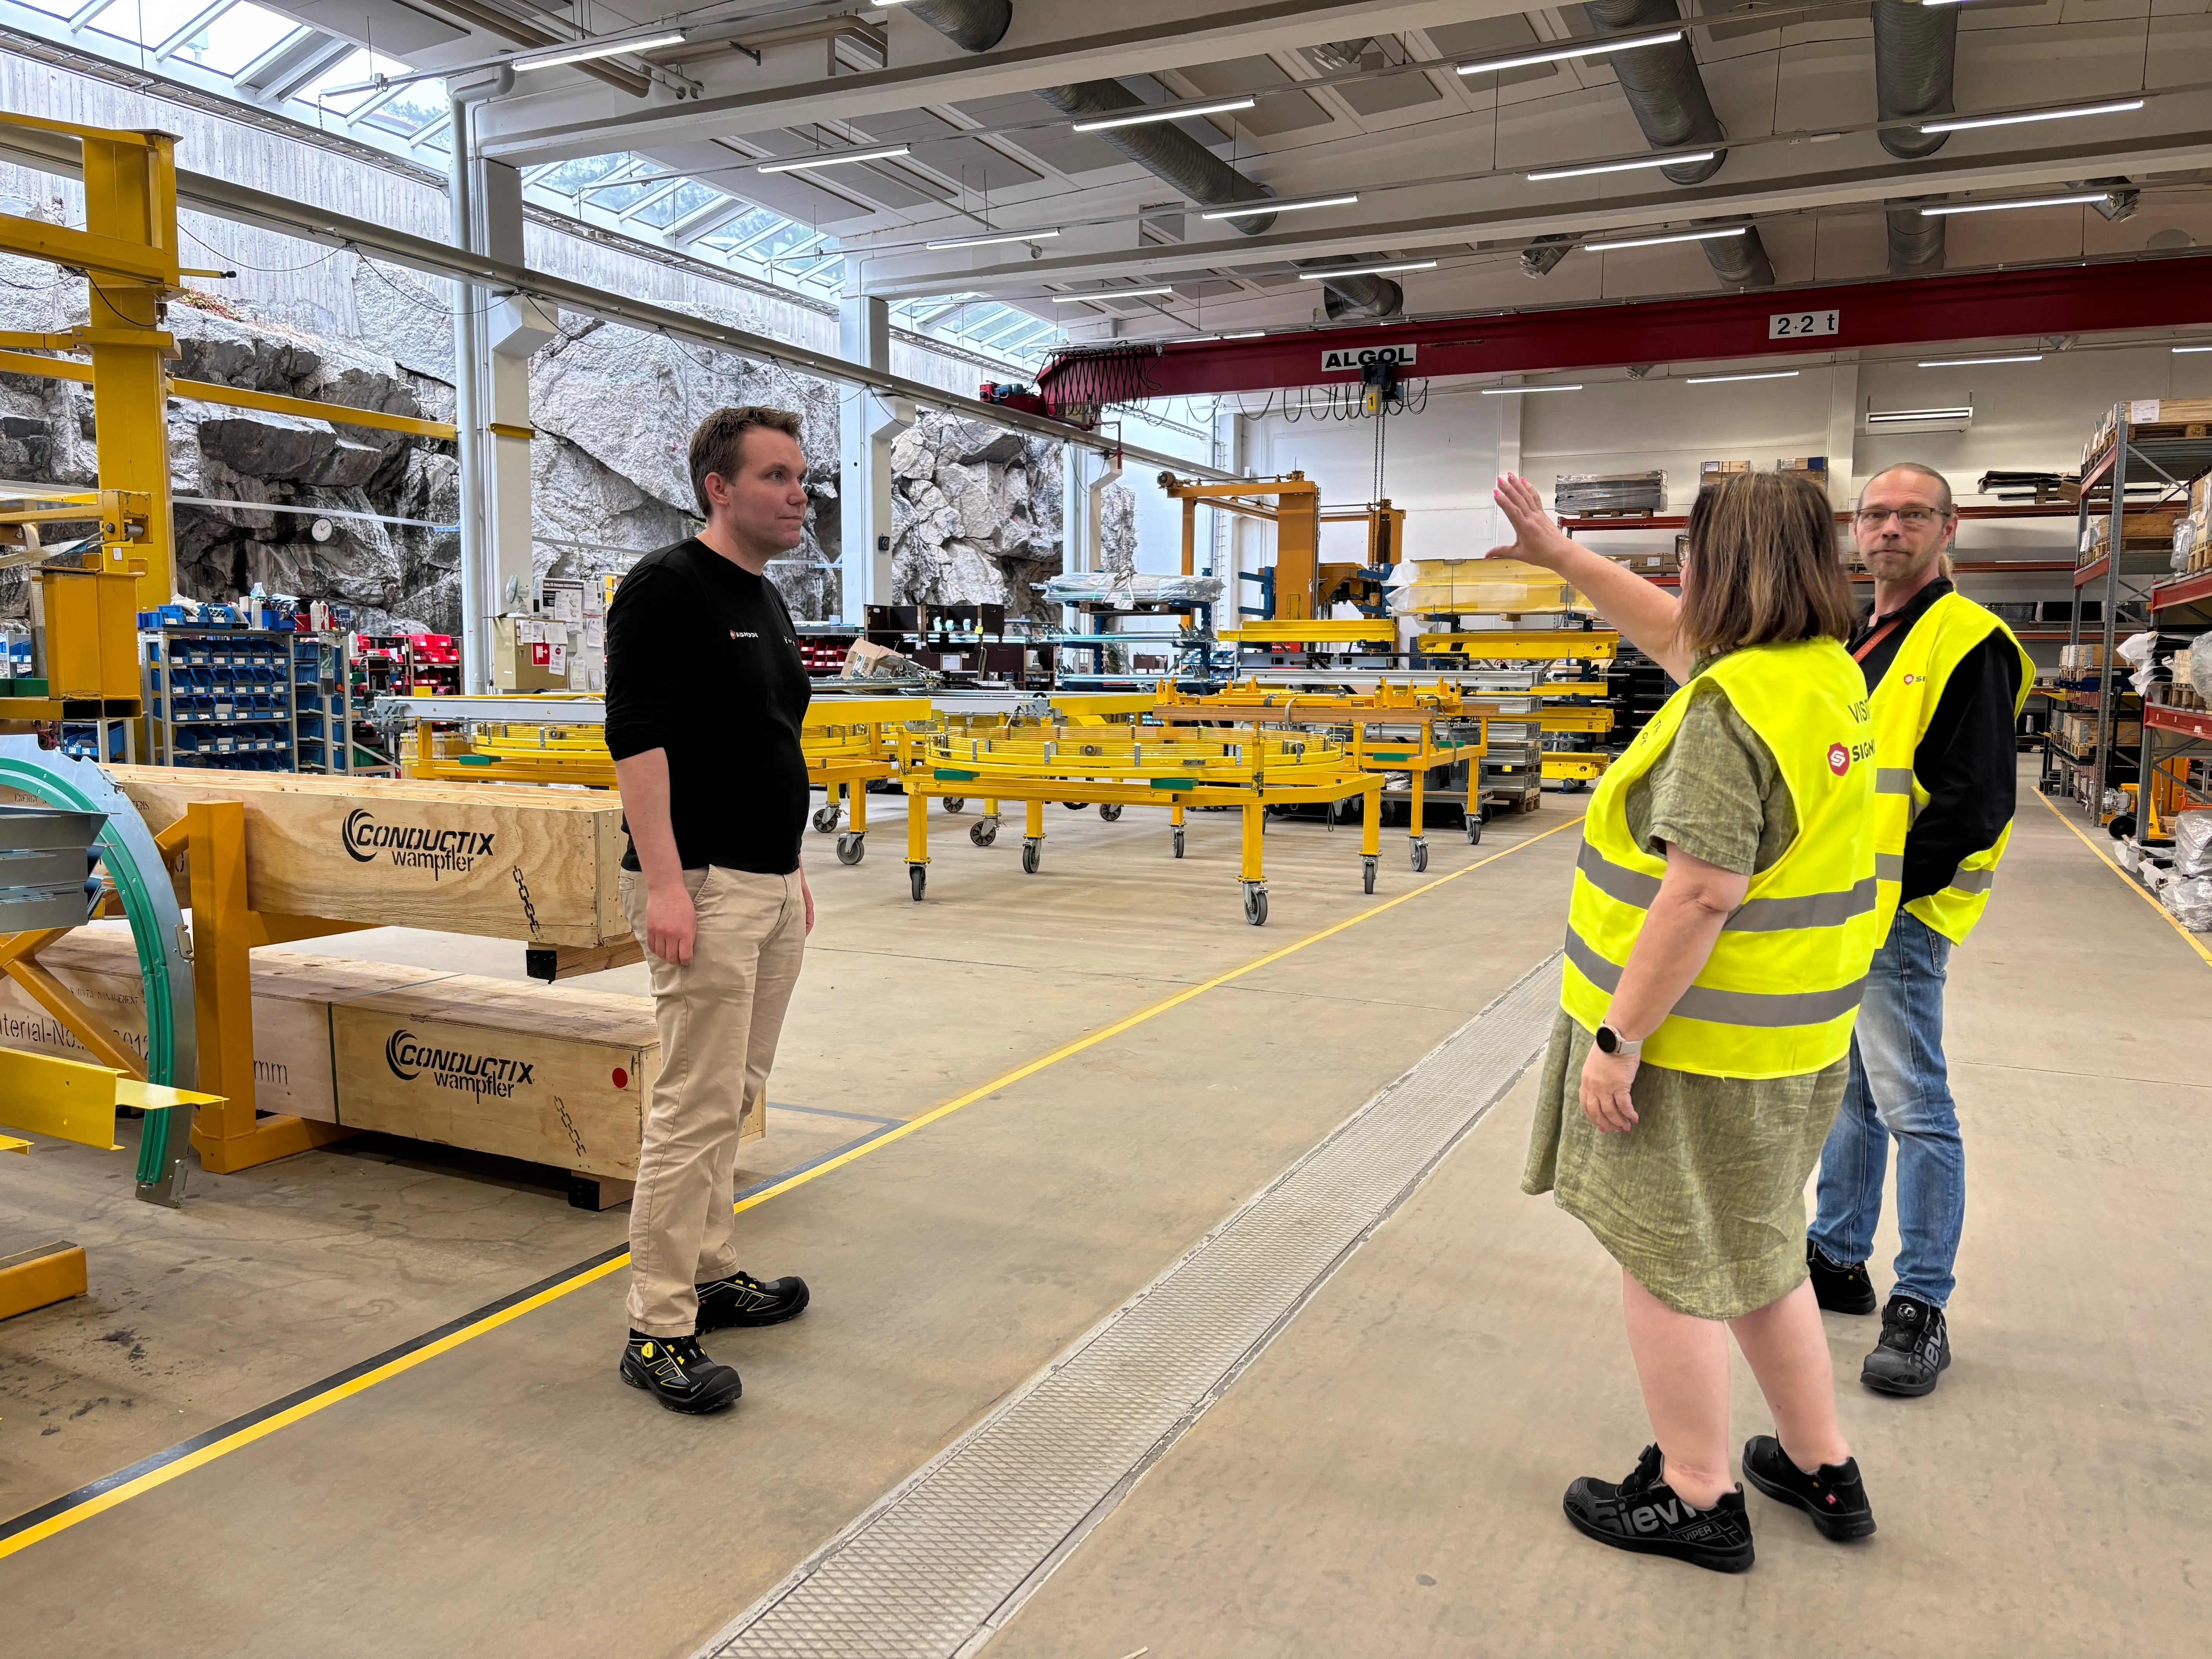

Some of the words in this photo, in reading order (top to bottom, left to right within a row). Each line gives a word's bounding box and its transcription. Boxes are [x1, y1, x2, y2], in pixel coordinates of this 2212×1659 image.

[1827, 314, 1835, 331] t
[1325, 347, 1414, 368] ALGOL
[1852, 738, 1875, 762] SIGN
[356, 824, 495, 856] CONDUCTIX
[392, 844, 475, 881] wampfler
[98, 992, 138, 1005] MANAGEMENT
[400, 1044, 534, 1085] CONDUCTIX
[434, 1070, 515, 1104] wampfler
[1681, 1525, 1712, 1541] VIPER
